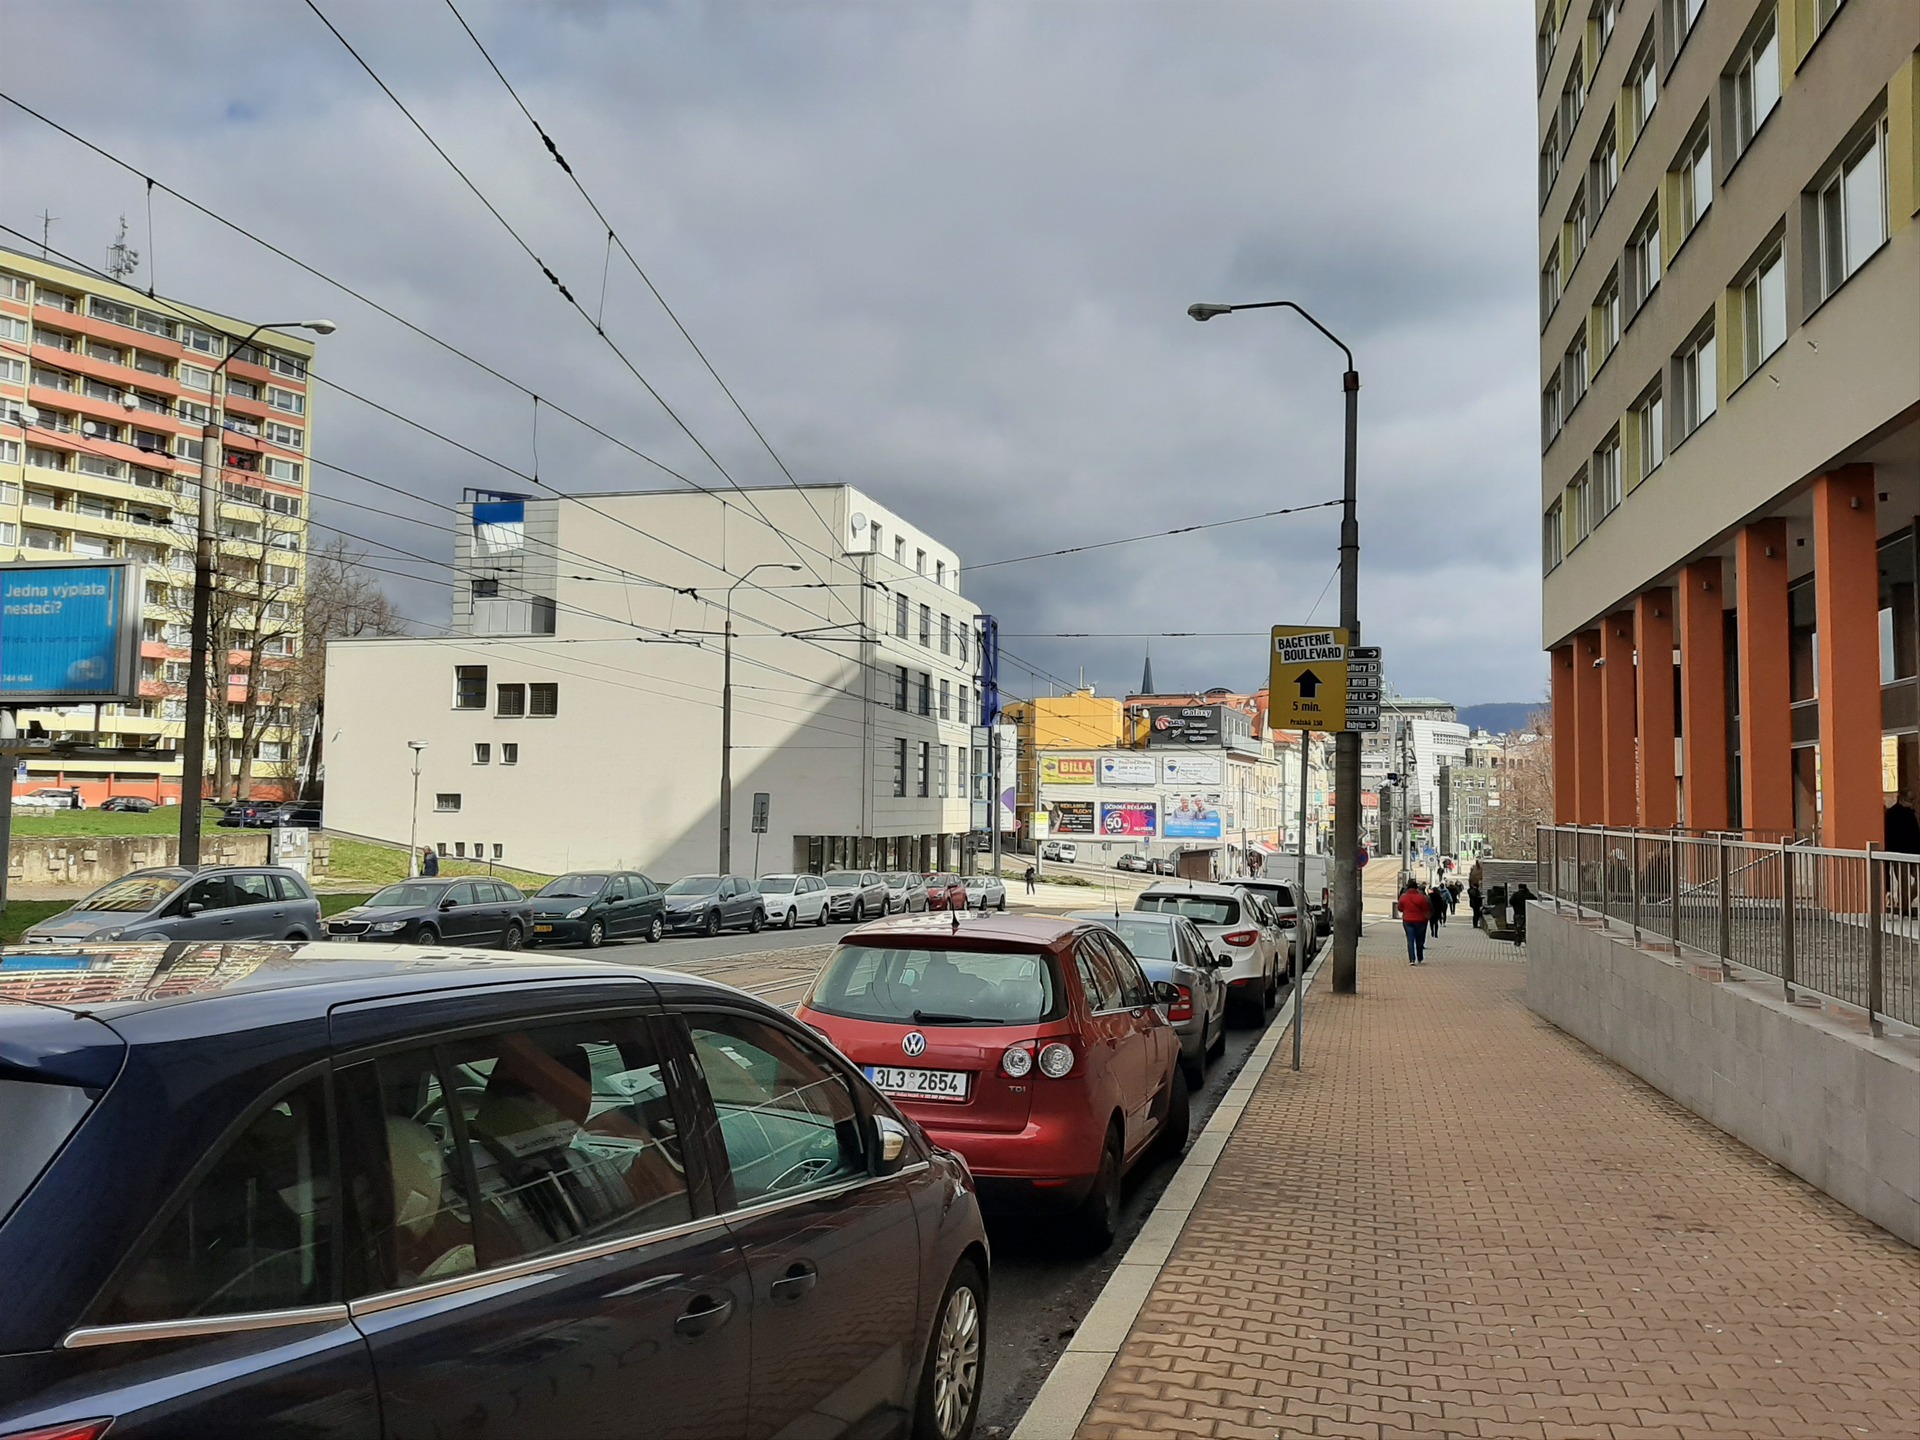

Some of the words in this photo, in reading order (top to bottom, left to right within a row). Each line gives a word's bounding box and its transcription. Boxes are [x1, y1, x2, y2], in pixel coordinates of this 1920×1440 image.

[5, 584, 48, 598] Jedna
[53, 582, 106, 599] výplata
[4, 600, 63, 615] nestačí?
[1278, 633, 1332, 650] BAGETERIE
[1284, 646, 1341, 661] BOULEVARD
[1182, 708, 1212, 718] Galaxy
[1292, 701, 1299, 712] 5
[1301, 702, 1322, 712] min.
[1060, 761, 1093, 773] BILLA
[1106, 817, 1122, 829] 50
[875, 1069, 906, 1088] 3L3
[917, 1073, 958, 1093] 2654
[1008, 1085, 1026, 1093] TDI
